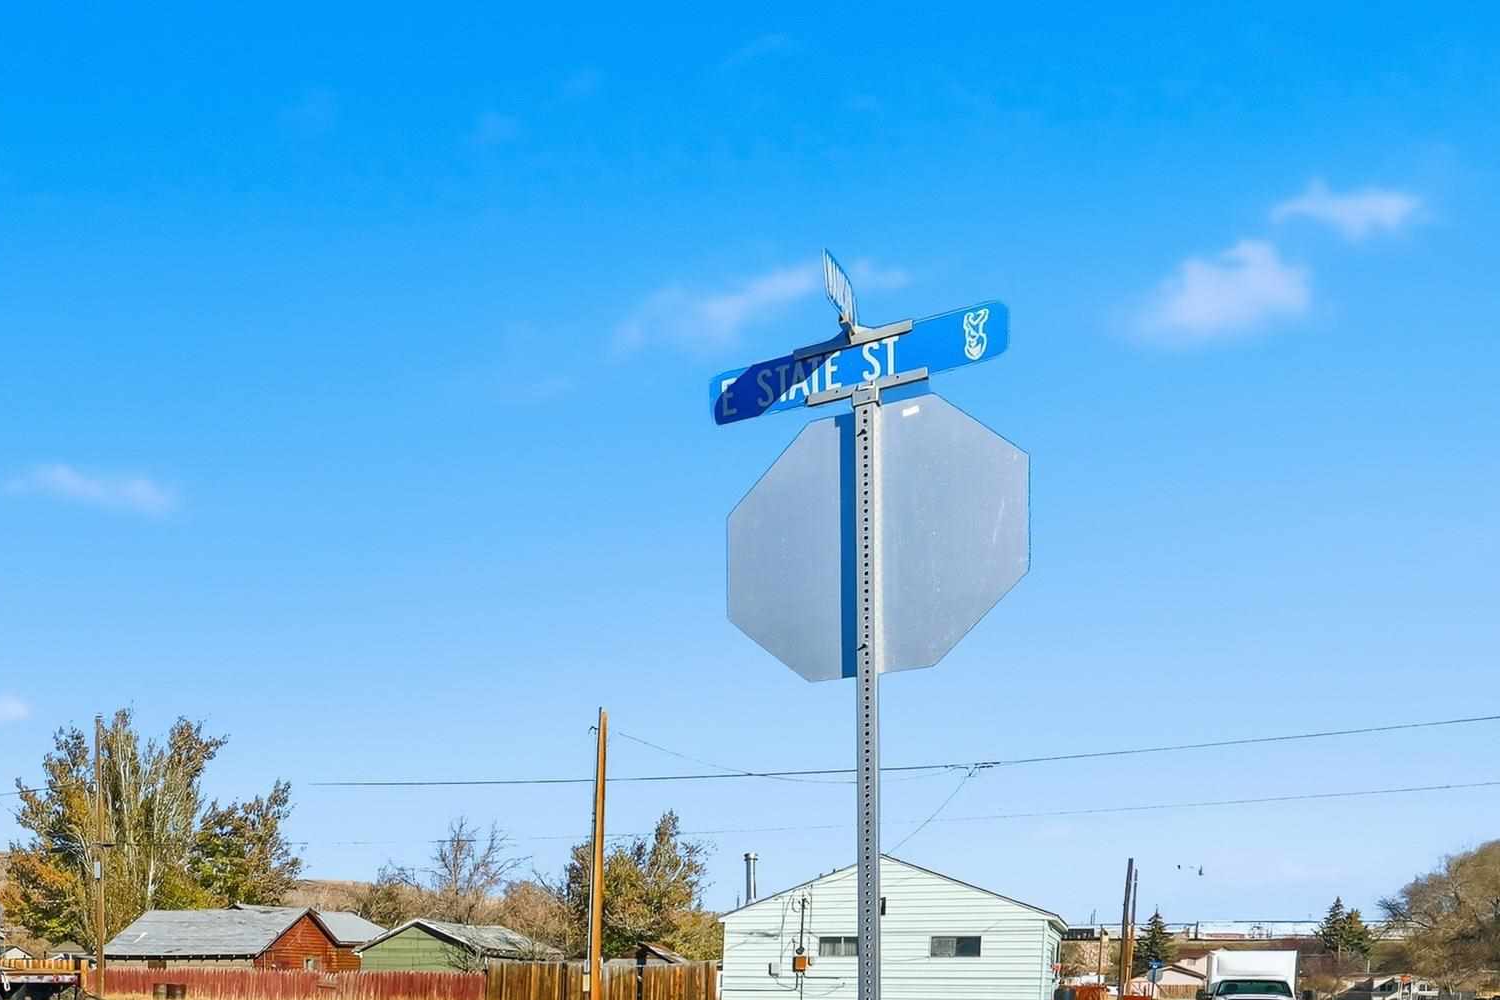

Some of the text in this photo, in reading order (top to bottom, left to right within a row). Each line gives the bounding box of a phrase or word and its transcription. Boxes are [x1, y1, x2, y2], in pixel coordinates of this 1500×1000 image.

[722, 335, 900, 417] E STATE ST
